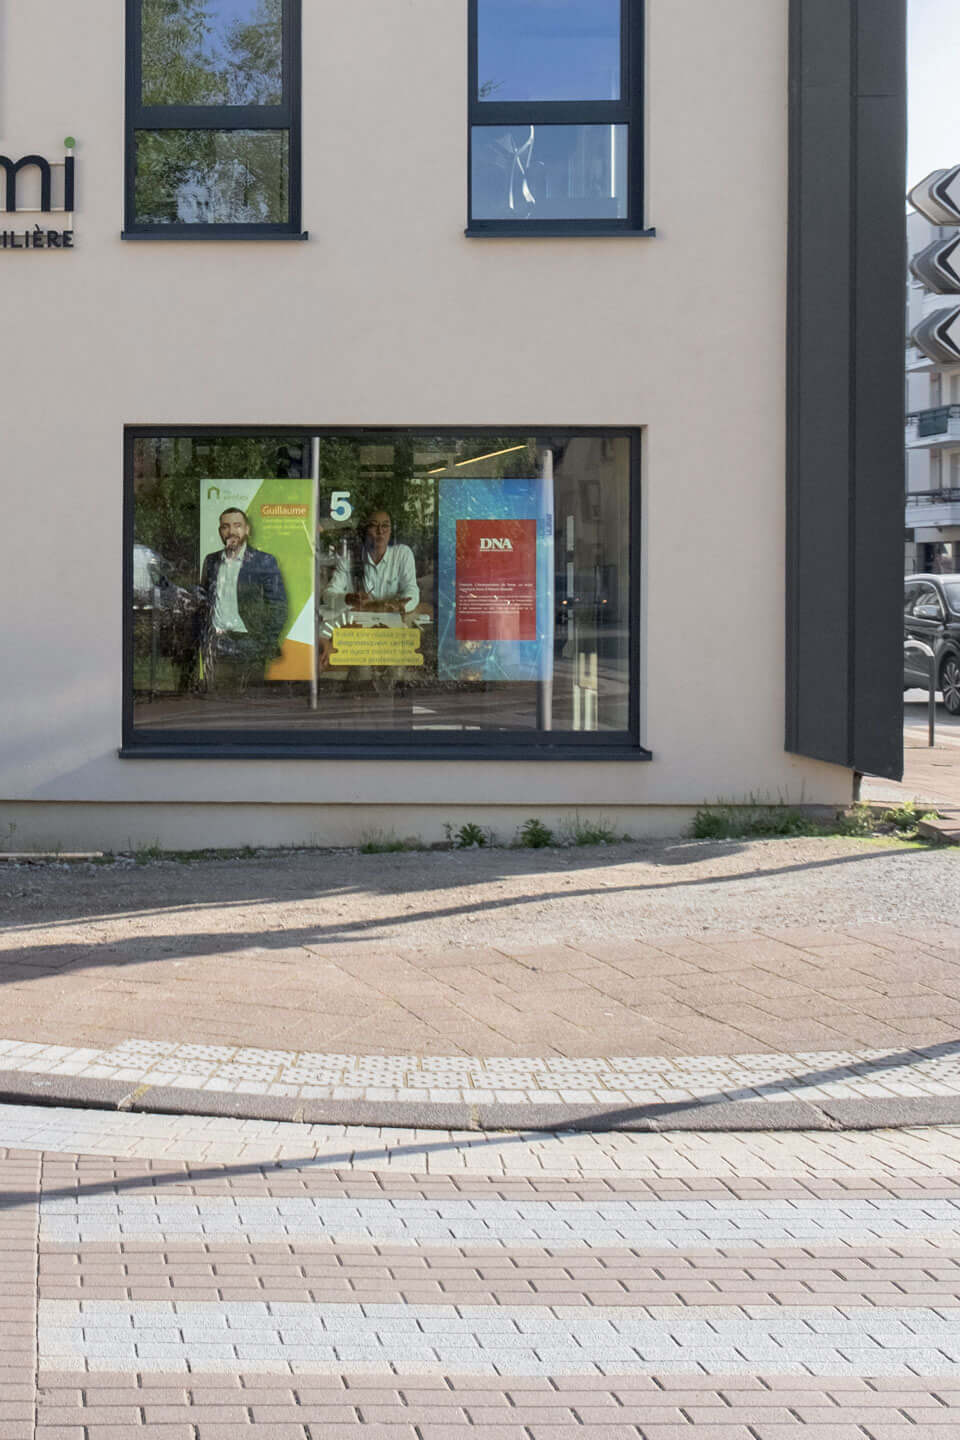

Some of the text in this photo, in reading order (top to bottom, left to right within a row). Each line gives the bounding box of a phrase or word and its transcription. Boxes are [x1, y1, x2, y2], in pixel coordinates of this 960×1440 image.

[262, 505, 307, 517] Guillaume
[330, 491, 352, 521] 5
[480, 538, 513, 549] DNA
